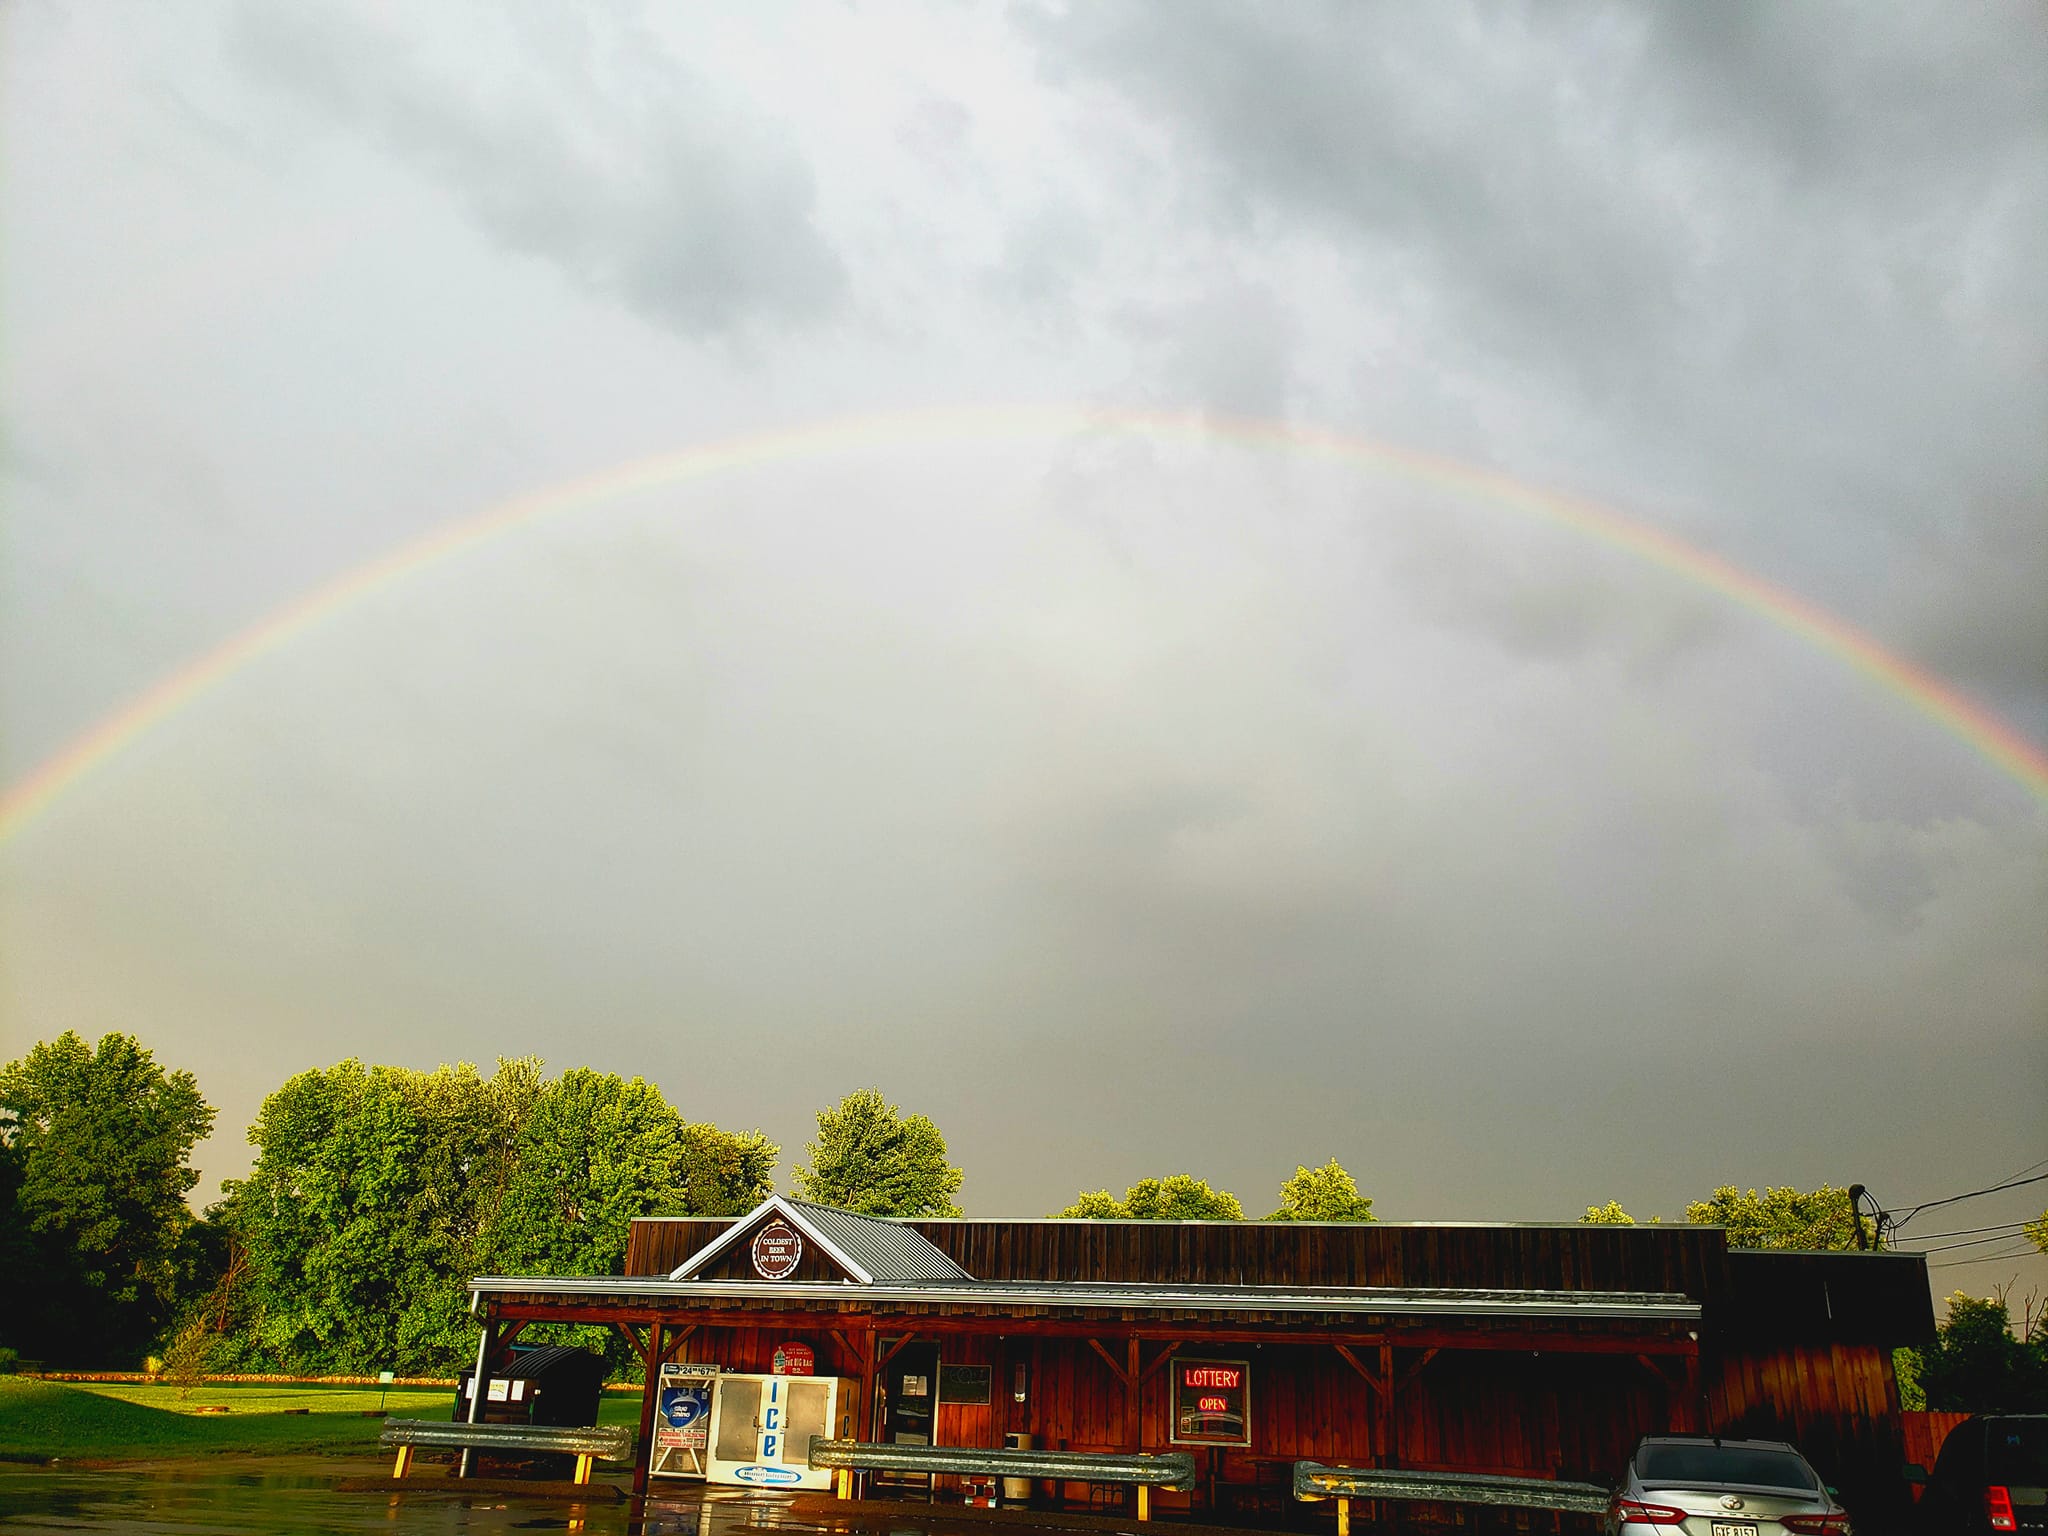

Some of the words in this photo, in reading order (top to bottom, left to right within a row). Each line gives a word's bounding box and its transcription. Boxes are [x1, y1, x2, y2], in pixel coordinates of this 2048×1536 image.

[762, 1238, 793, 1246] COLDEST
[768, 1246, 785, 1254] BEER
[770, 1255, 792, 1263] TOWN
[1185, 1369, 1240, 1387] LOTTERY
[1199, 1397, 1226, 1411] OPEN
[1733, 1527, 1754, 1536] 8157
